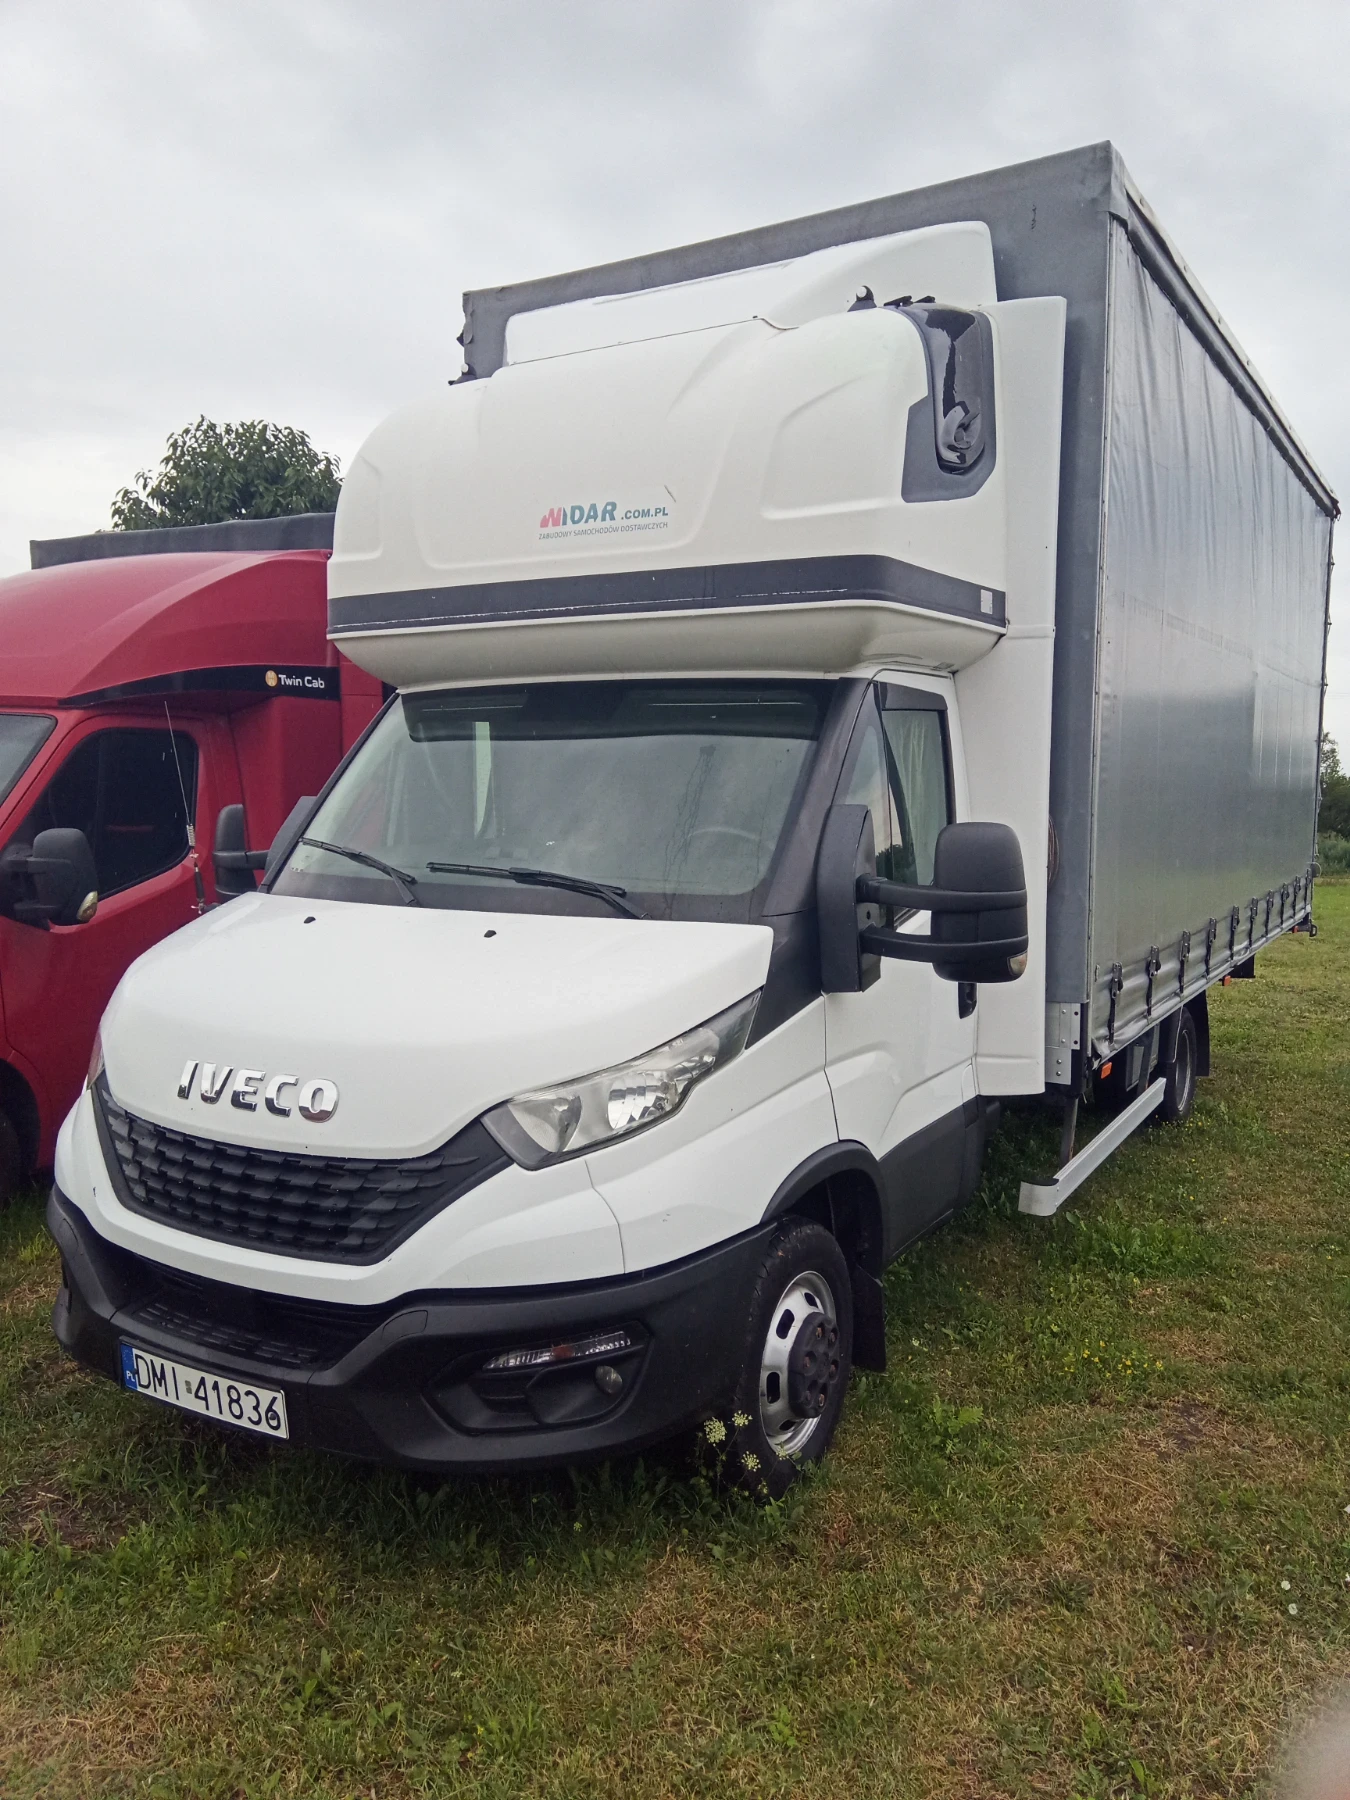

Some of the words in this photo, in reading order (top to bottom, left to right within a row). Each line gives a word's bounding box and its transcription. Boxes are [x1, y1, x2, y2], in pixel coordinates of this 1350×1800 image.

[538, 531, 573, 540] ZABUDOWY
[573, 525, 620, 536] SAMOCHODÓW
[620, 521, 668, 532] DOSTAWCZYCH
[278, 674, 303, 687] Twin
[304, 676, 325, 689] Cab
[177, 1059, 339, 1123] IVECO
[126, 1370, 136, 1382] PL
[134, 1353, 180, 1400] DMI
[194, 1376, 282, 1431] 41836
